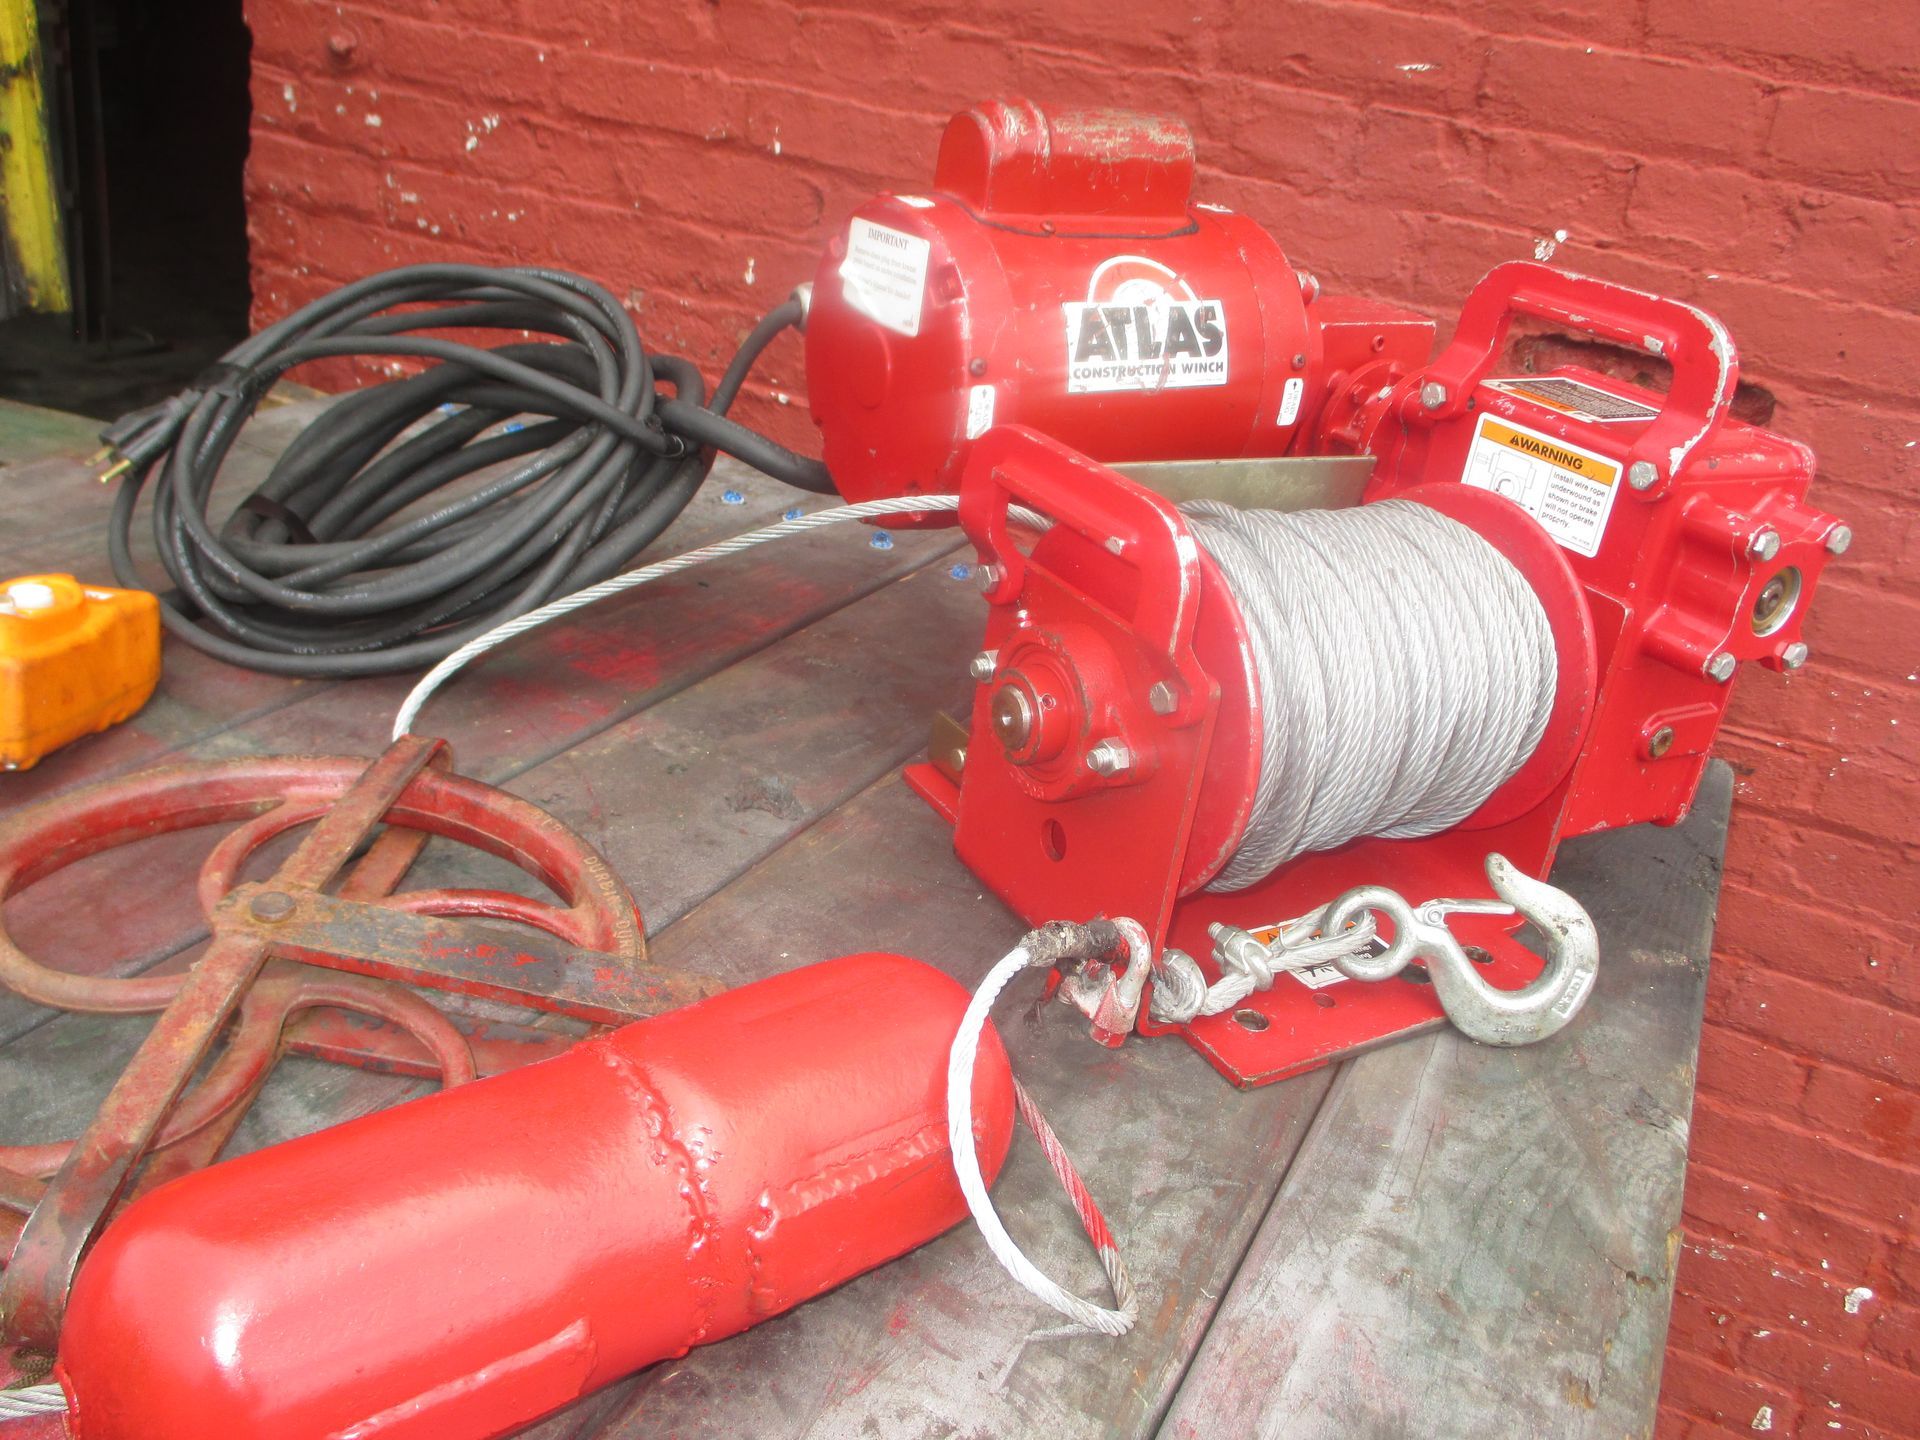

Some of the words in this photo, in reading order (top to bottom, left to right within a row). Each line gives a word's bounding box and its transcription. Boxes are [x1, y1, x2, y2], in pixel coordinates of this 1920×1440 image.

[868, 227, 909, 250] IMPORTANT
[1074, 305, 1224, 363] ATLAS
[1073, 362, 1177, 380] CONSTRUCTION
[1181, 361, 1224, 375] WINCH
[1520, 437, 1583, 470] WARNING
[1550, 483, 1592, 503] underwound
[1592, 499, 1601, 507] as
[1553, 471, 1574, 485] Install
[1574, 481, 1589, 491] wire
[1590, 487, 1606, 498] rope
[1545, 502, 1557, 511] will
[1557, 507, 1568, 515] not
[1569, 512, 1594, 527] operate
[1548, 492, 1569, 506] shown
[1579, 504, 1598, 517] brake
